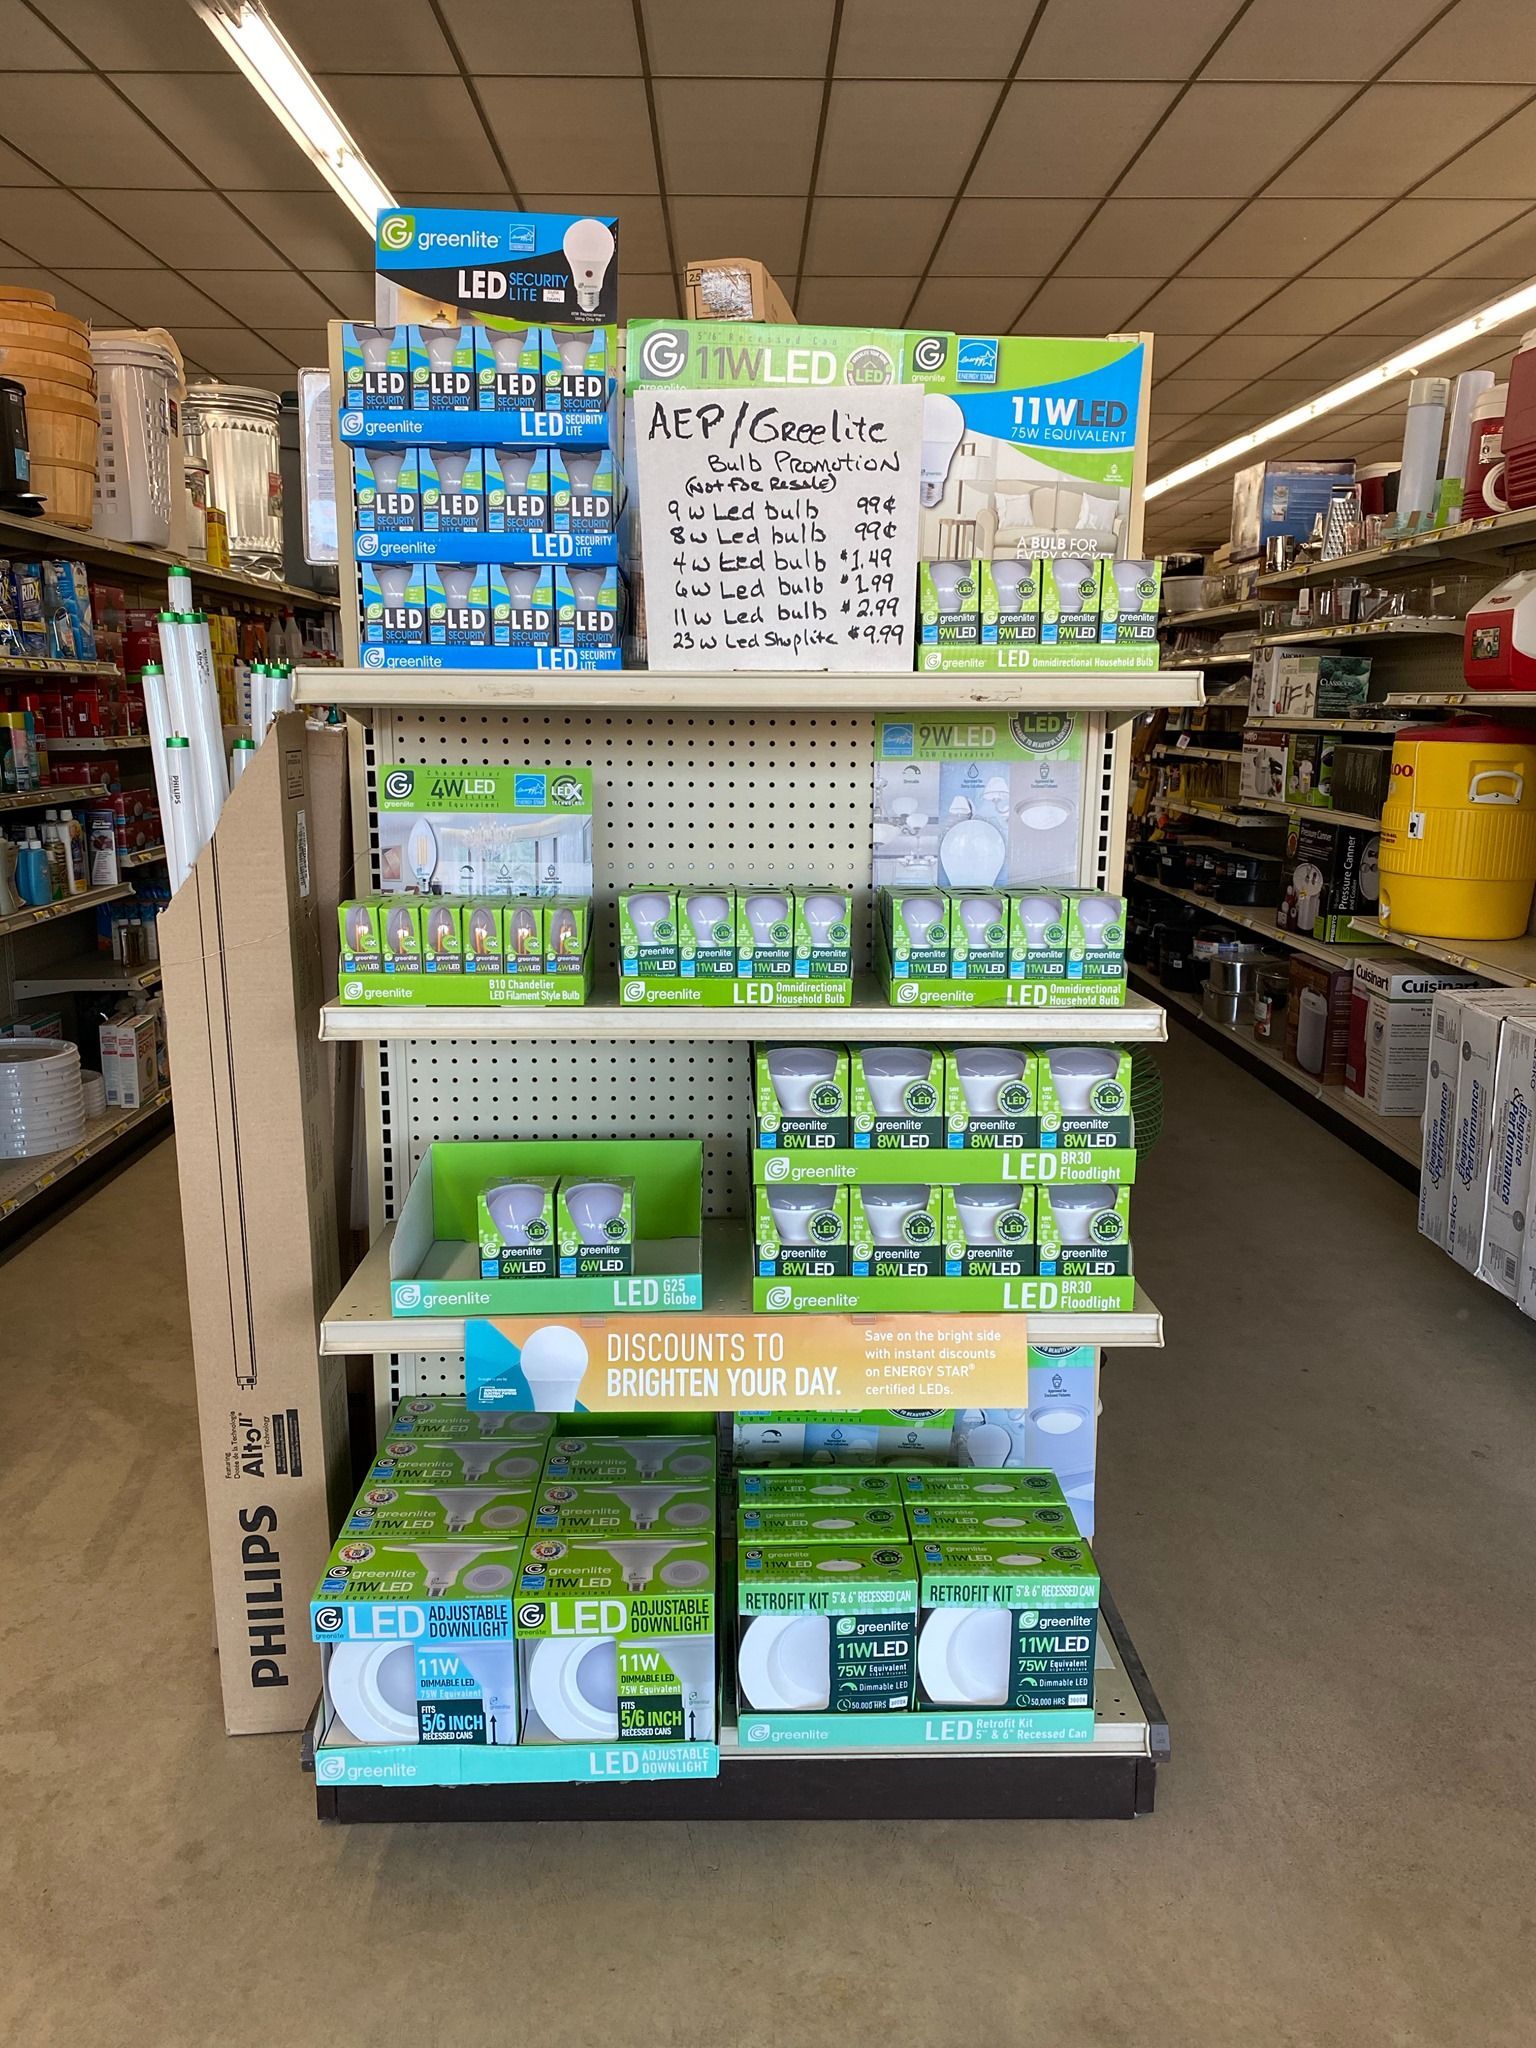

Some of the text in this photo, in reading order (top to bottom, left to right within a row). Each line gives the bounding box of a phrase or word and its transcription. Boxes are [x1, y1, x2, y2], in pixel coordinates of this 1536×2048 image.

[418, 229, 499, 250] greenlite
[458, 270, 568, 300] LED SECURITY
[509, 288, 537, 302] LITE
[366, 373, 405, 393] LED
[431, 373, 470, 394] LED
[911, 373, 945, 383] greenlite
[366, 395, 405, 405] SECURITY
[365, 418, 423, 435] greenlite
[521, 412, 603, 437] LED SECURITY
[566, 425, 583, 437] LITE
[1011, 427, 1127, 443] 75W EQUIVALENT
[708, 451, 762, 473] Bulb
[714, 501, 755, 521] Led
[765, 498, 819, 520] bulb
[717, 526, 760, 545] Led
[772, 522, 826, 545] bulb
[1017, 536, 1098, 551] A BULB FOR
[774, 548, 826, 572] bulb
[721, 578, 765, 600] Led
[779, 576, 824, 596] bulb
[724, 606, 764, 624] Led
[778, 601, 827, 621] bulb
[939, 626, 976, 640] 9WLED
[386, 654, 442, 669] greenlite
[537, 648, 617, 670] LED SECURITY
[580, 661, 597, 670] LITE
[942, 650, 1154, 671] greenlite LED Omnidirectional Household Bulb
[1024, 716, 1061, 732] LED
[172, 775, 182, 805] PHILIPS
[384, 801, 414, 809] greenlite
[1339, 835, 1356, 910] Pressure Canner
[639, 947, 674, 958] greenlite
[489, 980, 555, 990] B10 Chandelier
[1355, 963, 1389, 992] Cuisinart
[365, 987, 413, 999] greenlite
[489, 991, 580, 1002] LED Filament Style Bulb
[646, 982, 846, 1004] greenlite LED Omnidirectional
[776, 993, 845, 1004] Household Bulb
[782, 1119, 828, 1132] greenlite
[783, 1134, 836, 1148] 8WLED
[1515, 1102, 1528, 1168] Elegance
[1502, 1100, 1518, 1206] Performance
[791, 1152, 1092, 1181] greenlite LED BR30
[1060, 1167, 1121, 1183] Floodlight
[502, 1246, 542, 1257] greenlite
[502, 1260, 546, 1274] 6WLED
[423, 1279, 685, 1308] greenlite LED G25
[663, 1293, 697, 1306] Globe
[864, 1330, 1001, 1344] Save on the bright side
[607, 1333, 784, 1362] DISCOUNTS TO
[864, 1348, 996, 1360] with instant discounts
[865, 1368, 880, 1377] on
[884, 1366, 934, 1377] ENERGY
[607, 1367, 841, 1397] BRIGHTEN YOUR DAY.
[865, 1383, 953, 1395] certified LEDs.
[238, 1504, 289, 1688] PHILIPS
[930, 1585, 1094, 1603] RETROFIT KIT RECESSED CAN
[348, 1605, 507, 1640] LED ADJUSTABLE
[551, 1599, 709, 1635] LED ADJUSTABLE
[631, 1616, 709, 1633] DOWNLIGHT
[1038, 1615, 1092, 1631] greenlite
[315, 1621, 508, 1640] greenlite DOWNLIGHT
[419, 1657, 459, 1677] 11W
[1018, 1659, 1087, 1672] 75W Equivalent
[420, 1678, 475, 1688] DIMMABLE LED
[1039, 1678, 1088, 1687] Dimmable LED
[421, 1705, 436, 1714] FITS
[422, 1713, 484, 1732] 5/6 INCH
[771, 1718, 1033, 1743] greenlite LED Retrofit Kit
[422, 1731, 473, 1740] RECESSED CANS
[1017, 1728, 1087, 1740] Recessed Can
[347, 1749, 709, 1779] greenlite LED ADJUSTABLE
[642, 1761, 709, 1773] DOWNLIGHT
